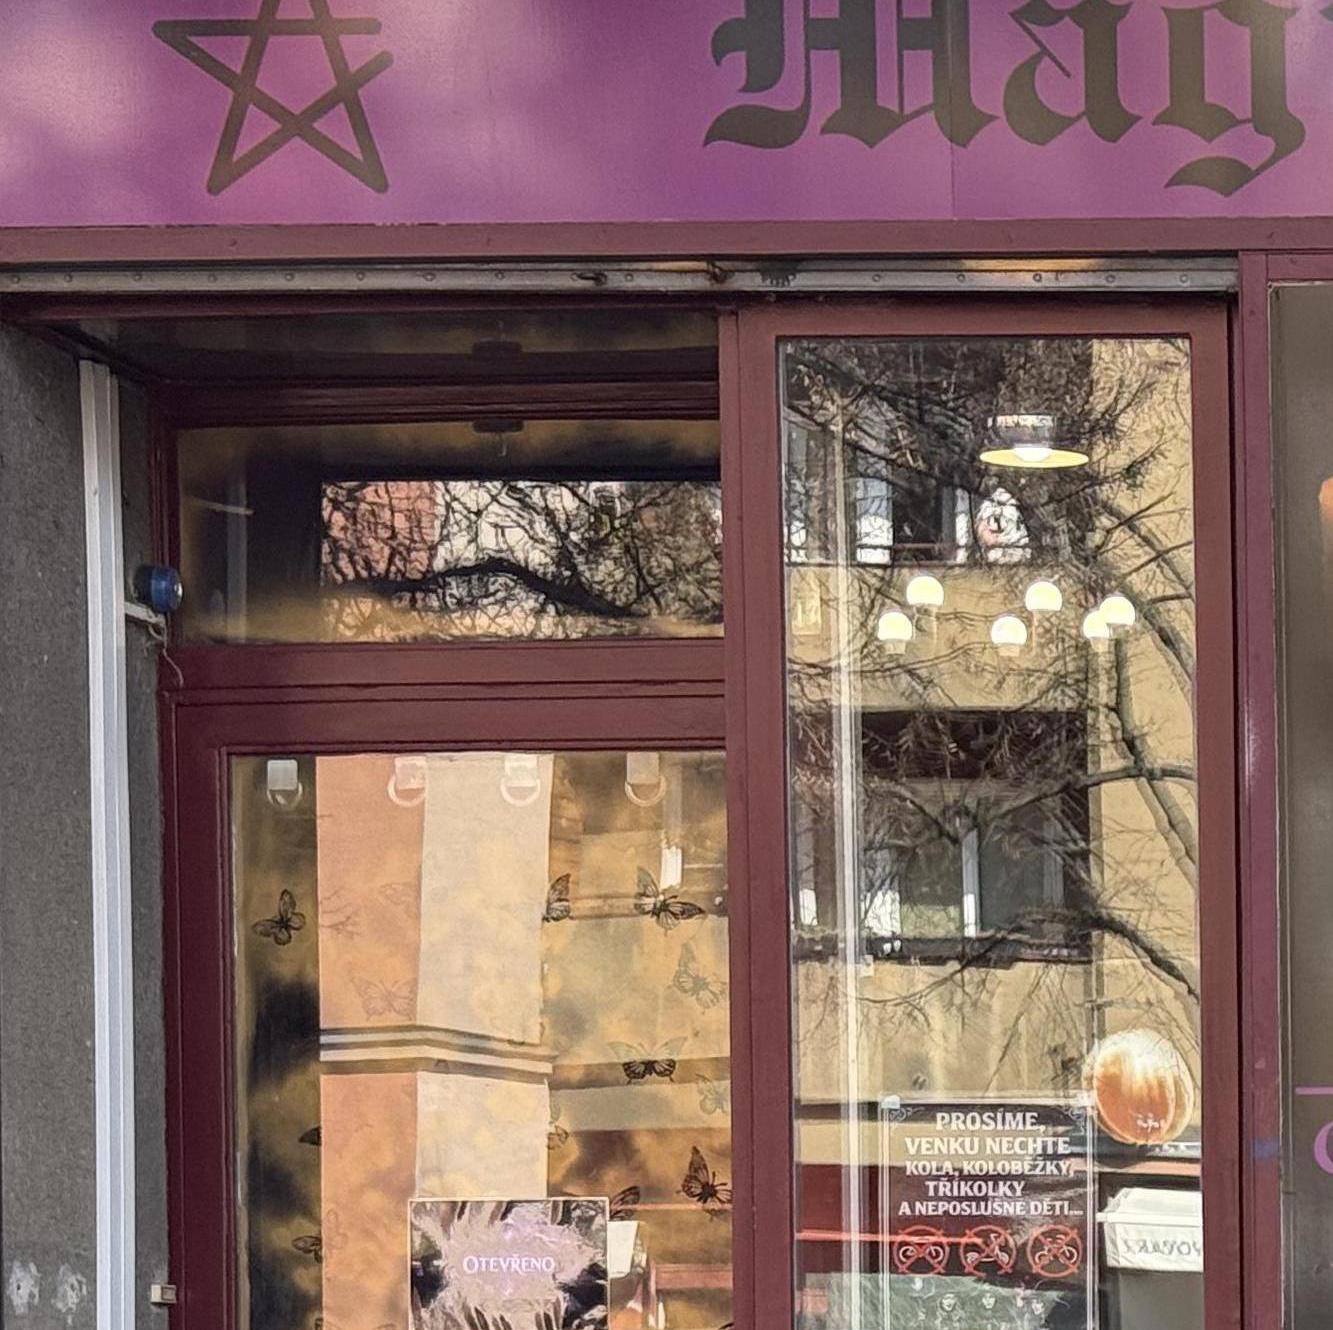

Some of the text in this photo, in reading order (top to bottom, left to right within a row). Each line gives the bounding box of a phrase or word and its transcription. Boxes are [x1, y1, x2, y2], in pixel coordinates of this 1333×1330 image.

[935, 1109, 1046, 1133] PROSÍME,
[904, 1137, 1072, 1155] VENKU NECHTE
[905, 1156, 1075, 1177] KOLA, KOLOBĚŽKY,
[925, 1178, 1025, 1196] TŘÍKOLKY
[898, 1201, 911, 1216] A
[463, 1254, 555, 1275] OTEVŘENO
